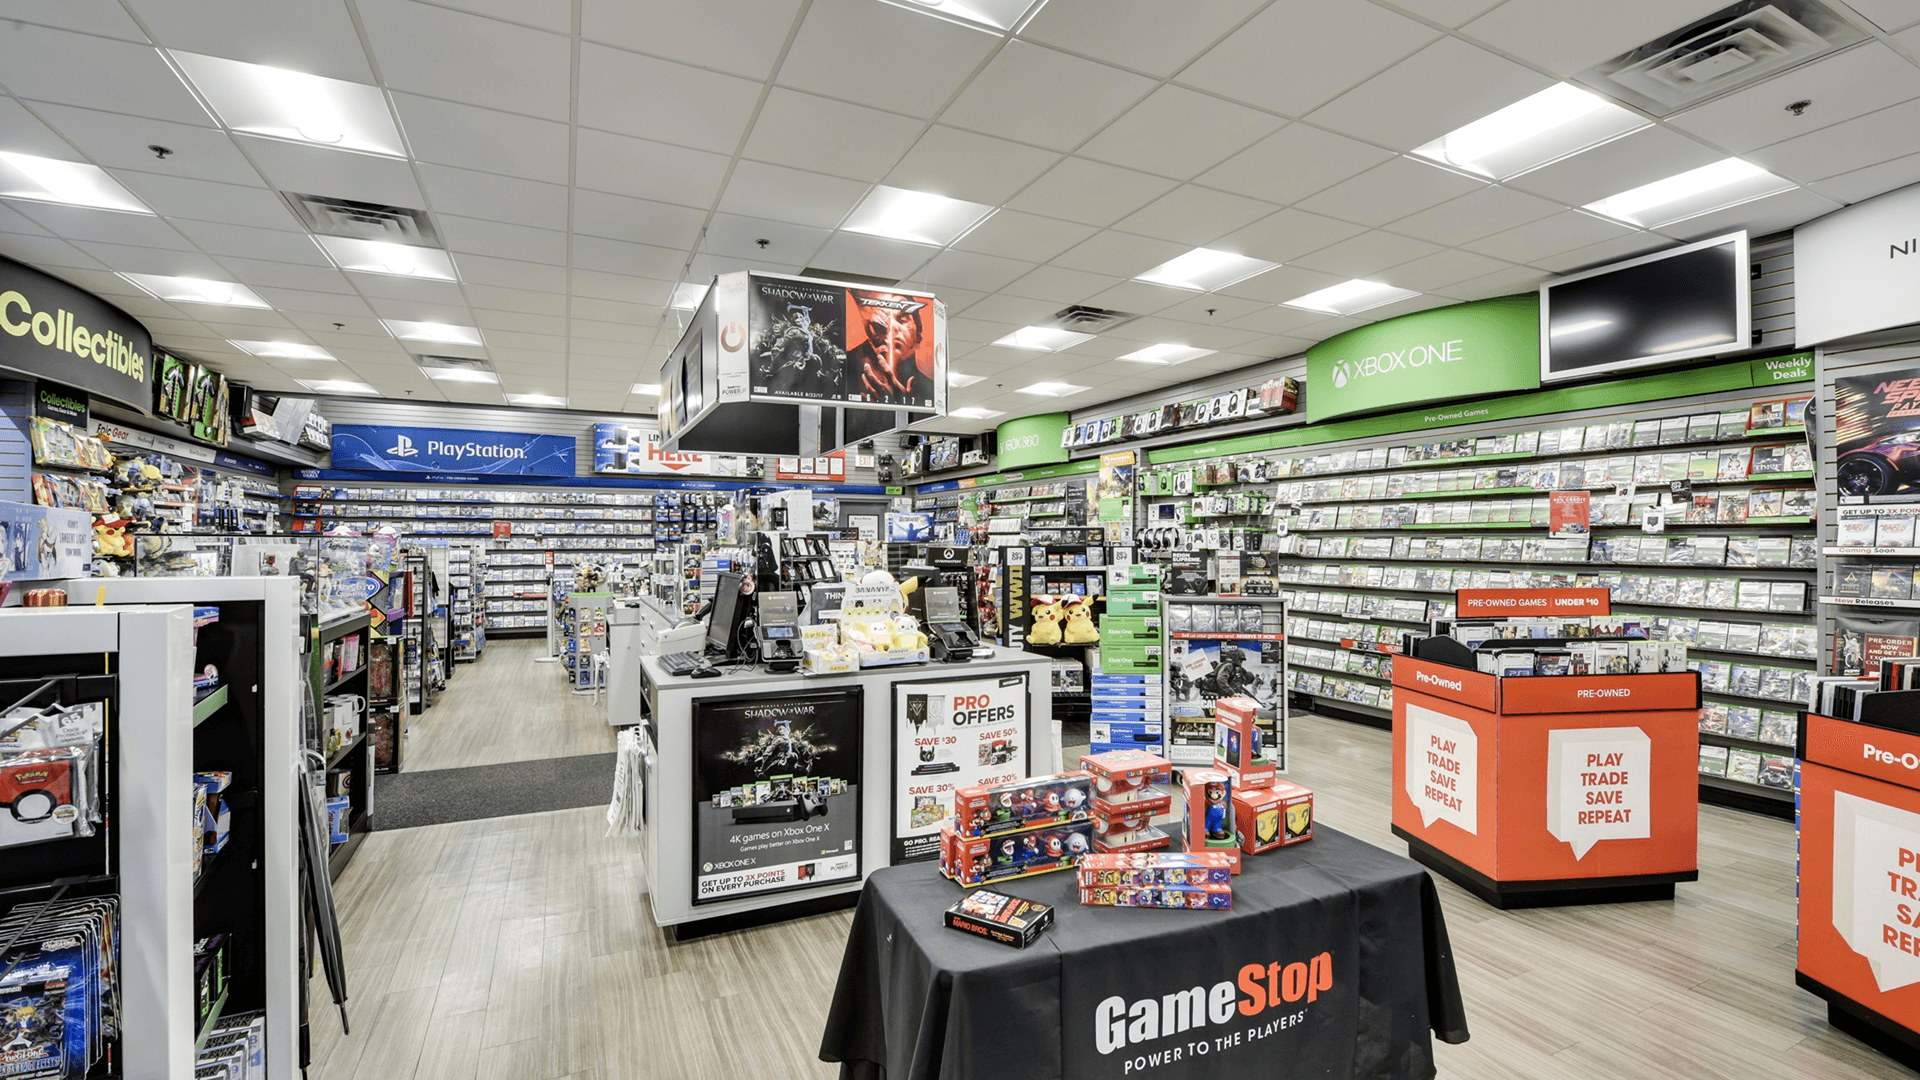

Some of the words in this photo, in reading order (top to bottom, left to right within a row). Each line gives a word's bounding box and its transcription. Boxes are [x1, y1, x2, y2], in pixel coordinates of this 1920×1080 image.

[762, 286, 807, 300] SHADOW
[812, 292, 834, 304] WAR
[862, 299, 905, 310] TEKKEN
[900, 300, 928, 313] 7
[0, 290, 144, 383] Collectibles
[1353, 348, 1406, 380] XBOX
[1408, 339, 1462, 368] ONE
[1765, 357, 1812, 371] Weekly
[1773, 368, 1807, 380] Deals
[41, 390, 86, 413] Collectibles
[1425, 411, 1463, 423] Pre-Owned
[1464, 408, 1489, 418] Games
[113, 427, 129, 440] Gear
[428, 441, 524, 460] PlayStation
[1467, 598, 1517, 607] PRE-OWNED
[1519, 598, 1547, 607] GAMES
[1554, 598, 1584, 606] UNDER
[1586, 597, 1599, 606] $10
[1856, 598, 1894, 606] Releases
[1869, 637, 1912, 646] PRE-ORDER
[1416, 670, 1462, 691] Pre-Owned
[1577, 688, 1631, 698] PRE-OWNED
[953, 694, 990, 711] PRO
[744, 708, 788, 719] SHADOW
[794, 705, 815, 715] WAR
[952, 704, 1014, 726] OFFERS
[914, 737, 939, 746] SAVE
[979, 730, 1001, 741] SAVE
[1003, 727, 1018, 737] 50%
[1431, 735, 1456, 755] PLAY
[1427, 750, 1460, 775] TRADE
[1586, 753, 1623, 768] PLAY
[1863, 743, 1920, 770] Pre-O
[978, 776, 999, 786] SAVE
[1430, 769, 1456, 792] SAVE
[1580, 771, 1628, 787] TRADE
[909, 785, 934, 795] SAVE
[936, 782, 956, 793] 30%
[1425, 784, 1463, 812] REPEAT
[1585, 791, 1623, 805] SAVE
[1578, 809, 1631, 825] REPEAT
[729, 834, 742, 843] 4K
[742, 833, 770, 844] games
[783, 827, 804, 837] Xbox
[805, 825, 822, 834] One
[824, 823, 830, 831] X
[714, 860, 735, 870] XBOX
[735, 859, 750, 867] ONE
[702, 879, 718, 887] GET
[720, 877, 731, 885] UP
[757, 869, 785, 879] POINTS
[702, 886, 714, 894] ON
[716, 882, 742, 892] EVERY
[743, 876, 785, 887] PURCHASE
[953, 918, 971, 930] MARIO
[1095, 951, 1333, 1055] GameStop
[1124, 1047, 1182, 1075] POWER
[1188, 1041, 1209, 1057] TO
[1215, 1032, 1240, 1051] THE
[1248, 1010, 1304, 1042] PLAYERS
